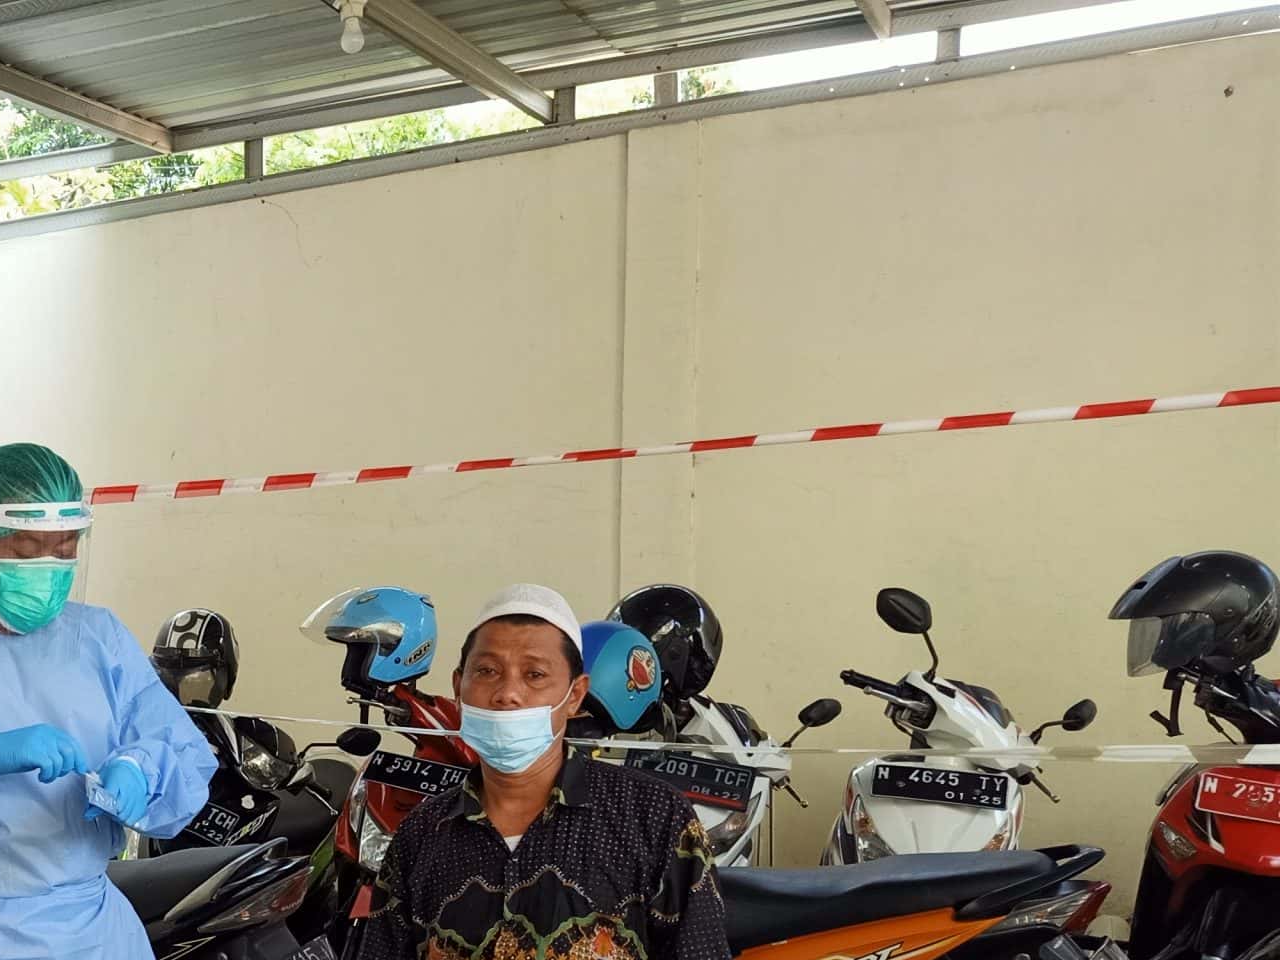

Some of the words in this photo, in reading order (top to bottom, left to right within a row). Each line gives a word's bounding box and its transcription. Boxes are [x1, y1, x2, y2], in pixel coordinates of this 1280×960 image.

[441, 767, 463, 784] TH
[714, 768, 748, 787] TCF
[877, 767, 890, 779] N
[908, 769, 961, 786] 4645
[979, 776, 1005, 792] TY
[1204, 776, 1219, 793] N
[207, 808, 237, 830] TCH
